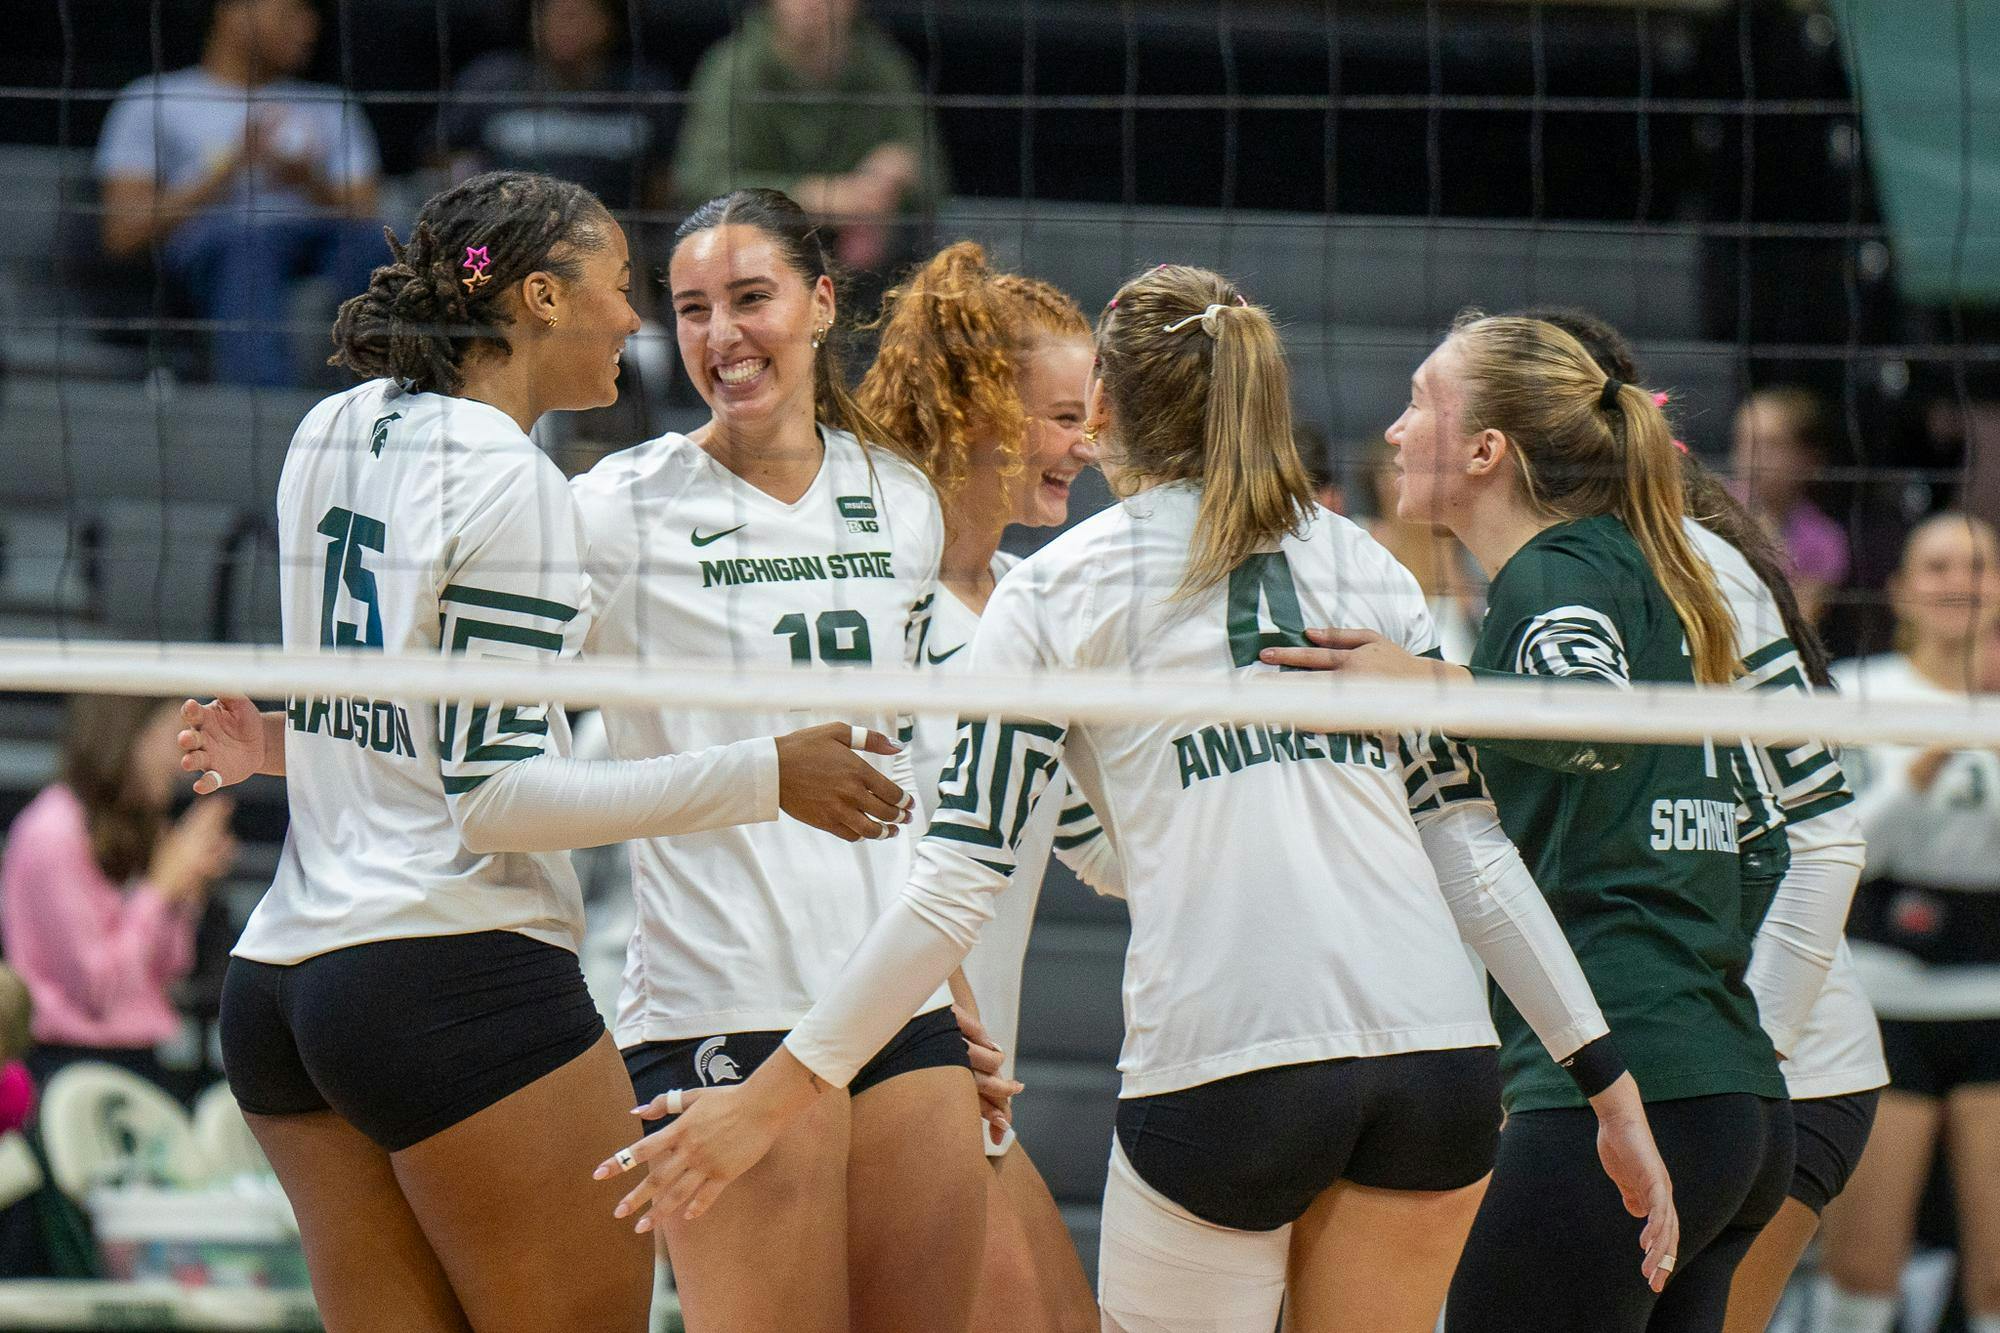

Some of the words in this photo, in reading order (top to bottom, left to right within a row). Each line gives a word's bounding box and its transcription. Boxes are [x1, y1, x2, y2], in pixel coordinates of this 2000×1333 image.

[317, 506, 386, 654] 15
[699, 557, 827, 587] MICHIGAN
[829, 552, 895, 579] STATE
[1172, 721, 1387, 790] ANDREWS
